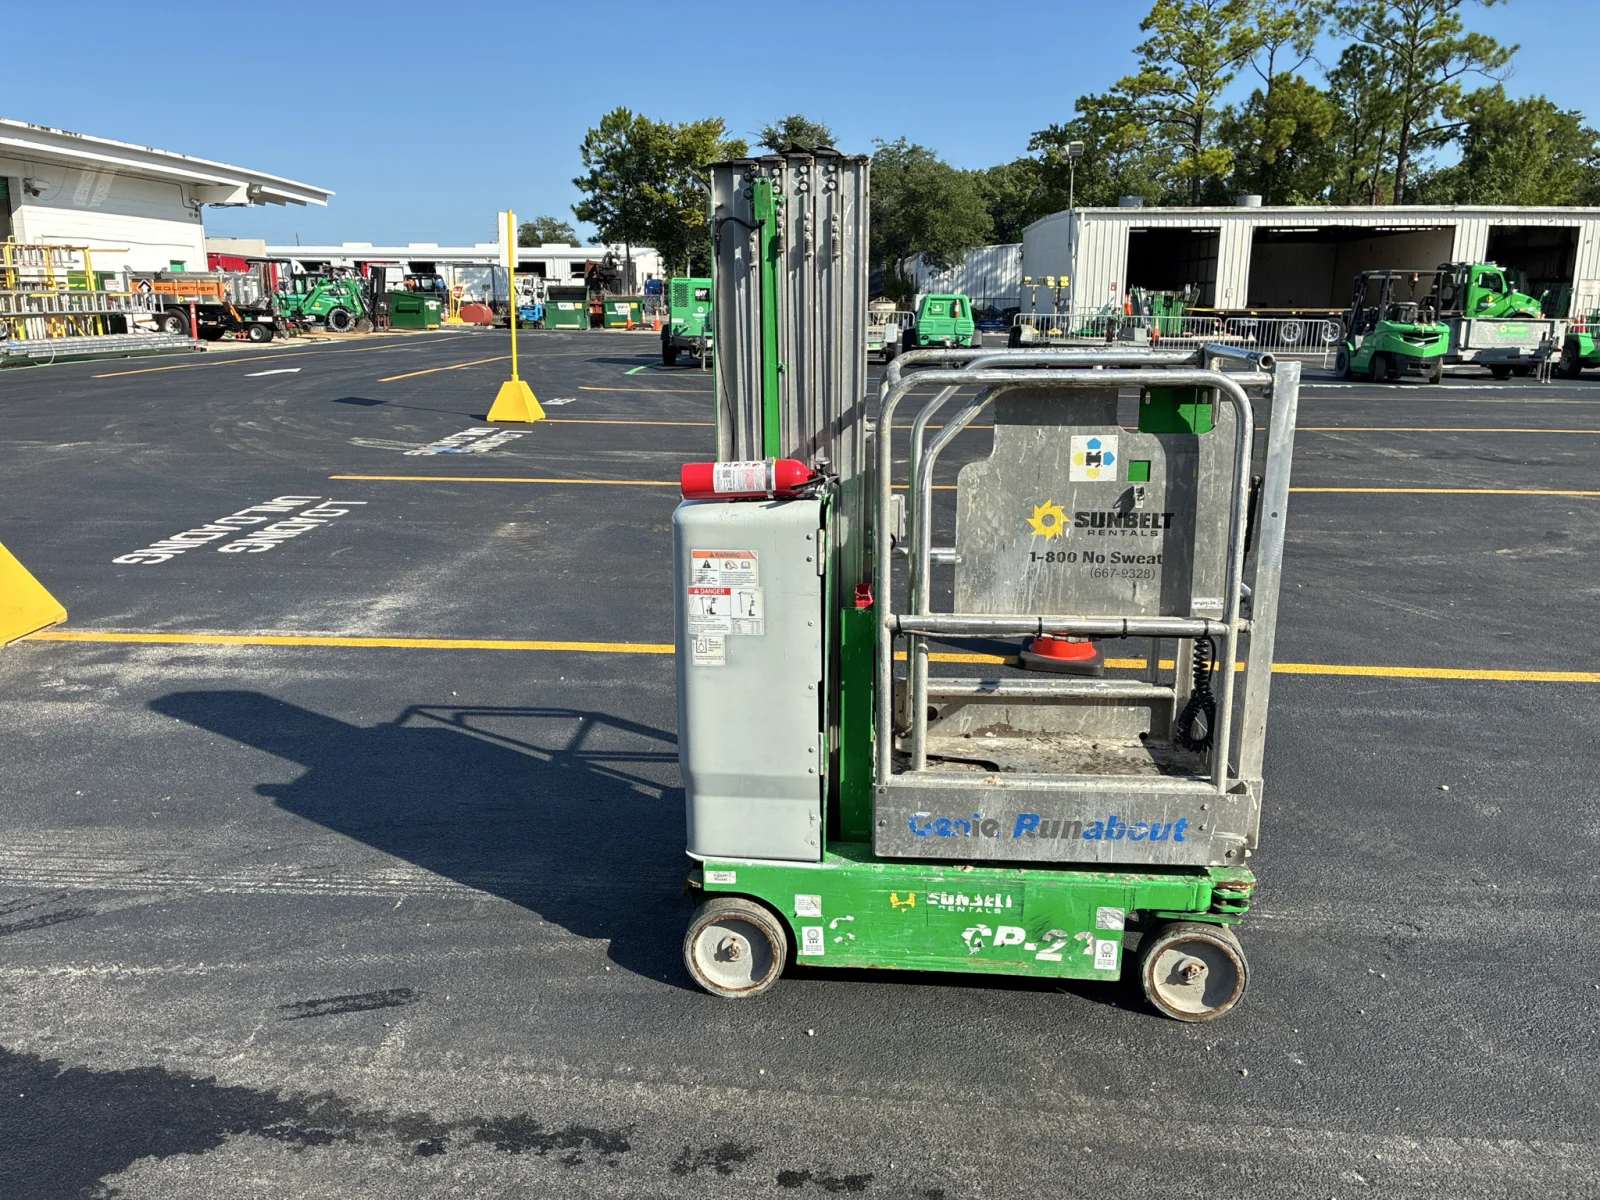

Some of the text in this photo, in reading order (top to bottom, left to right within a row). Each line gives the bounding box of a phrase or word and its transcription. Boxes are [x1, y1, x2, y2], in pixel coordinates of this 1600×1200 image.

[217, 501, 368, 553] LOADING
[1074, 511, 1175, 529] SUNBELT
[111, 495, 322, 564] UNLOADING
[1087, 529, 1159, 537] RENTALS
[1029, 551, 1163, 565] 1-800 No Sweat
[1089, 567, 1156, 579] (667-9328)
[908, 811, 1189, 843] Genie Runabout
